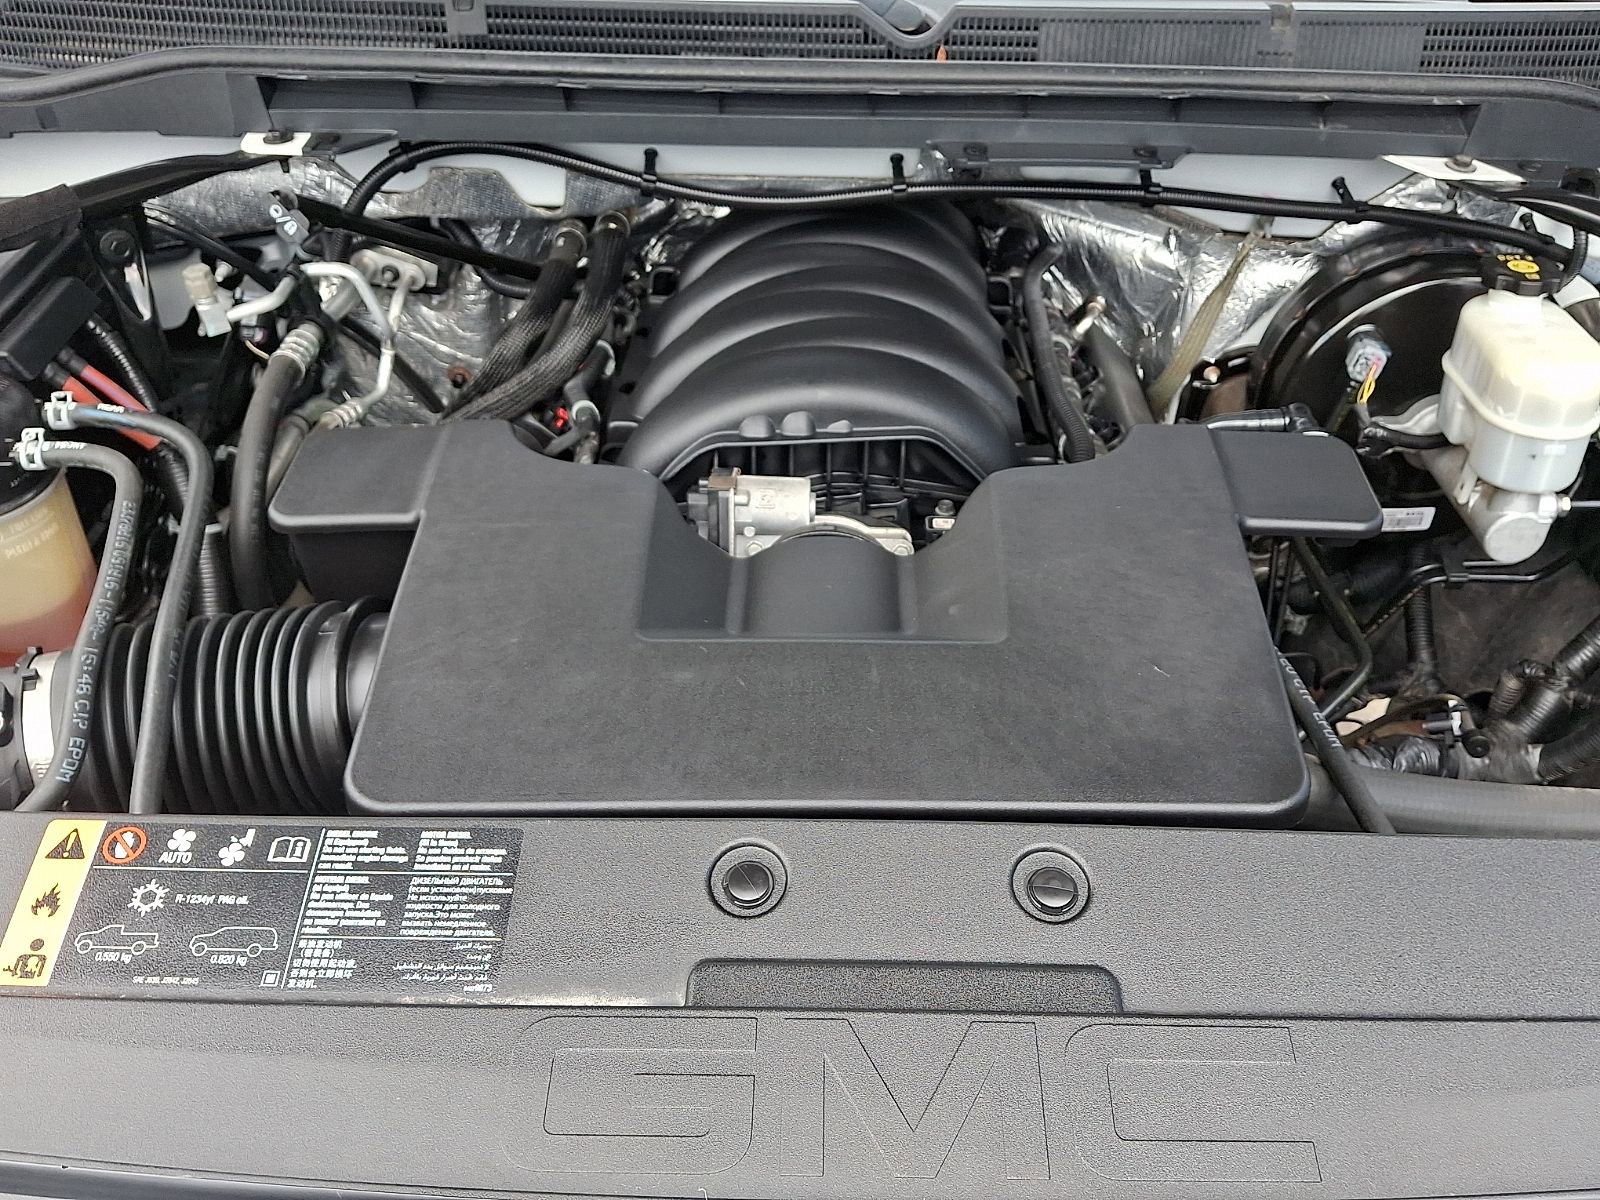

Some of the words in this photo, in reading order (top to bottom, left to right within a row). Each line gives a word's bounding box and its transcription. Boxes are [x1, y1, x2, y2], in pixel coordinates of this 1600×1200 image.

[56, 737, 85, 782] EPDM
[158, 852, 192, 863] AUTO
[121, 952, 132, 964] kg
[236, 955, 248, 966] kg
[504, 1015, 1322, 1182] GMC
